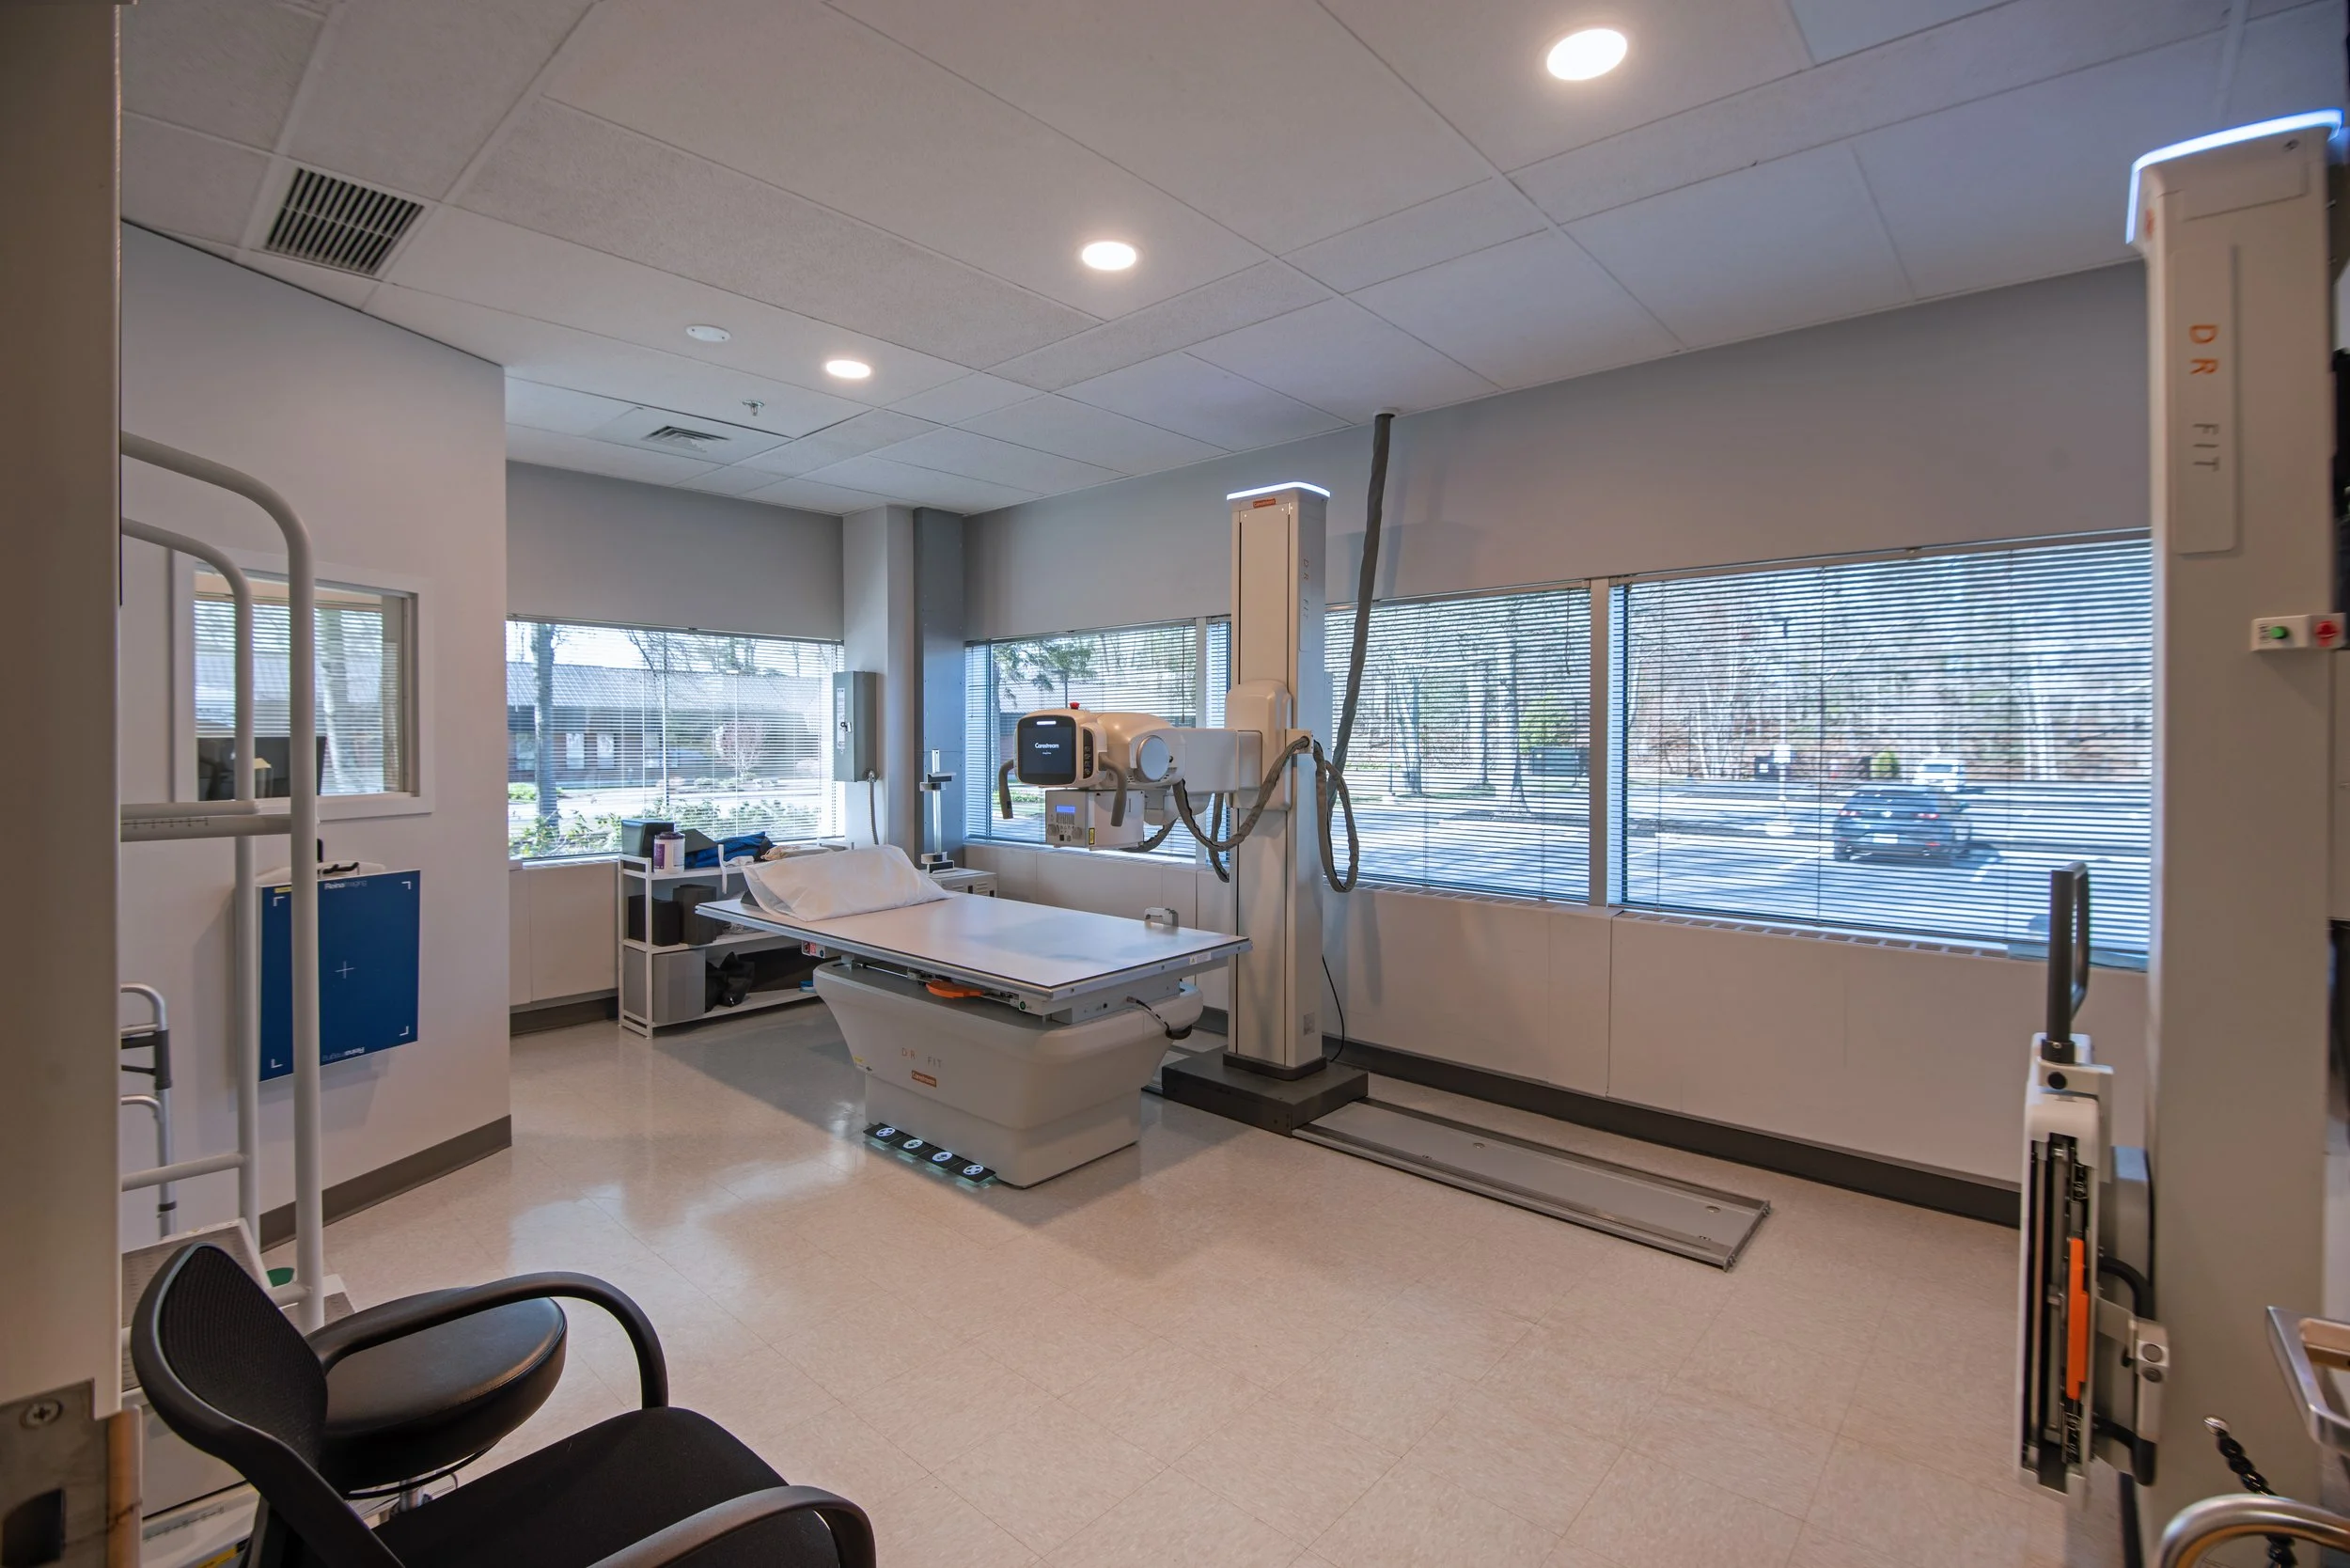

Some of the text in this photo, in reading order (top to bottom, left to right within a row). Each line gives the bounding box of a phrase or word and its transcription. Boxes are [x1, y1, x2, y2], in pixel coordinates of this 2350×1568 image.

[2189, 323, 2220, 472] DR FIT
[901, 1047, 942, 1069] DR FIT
